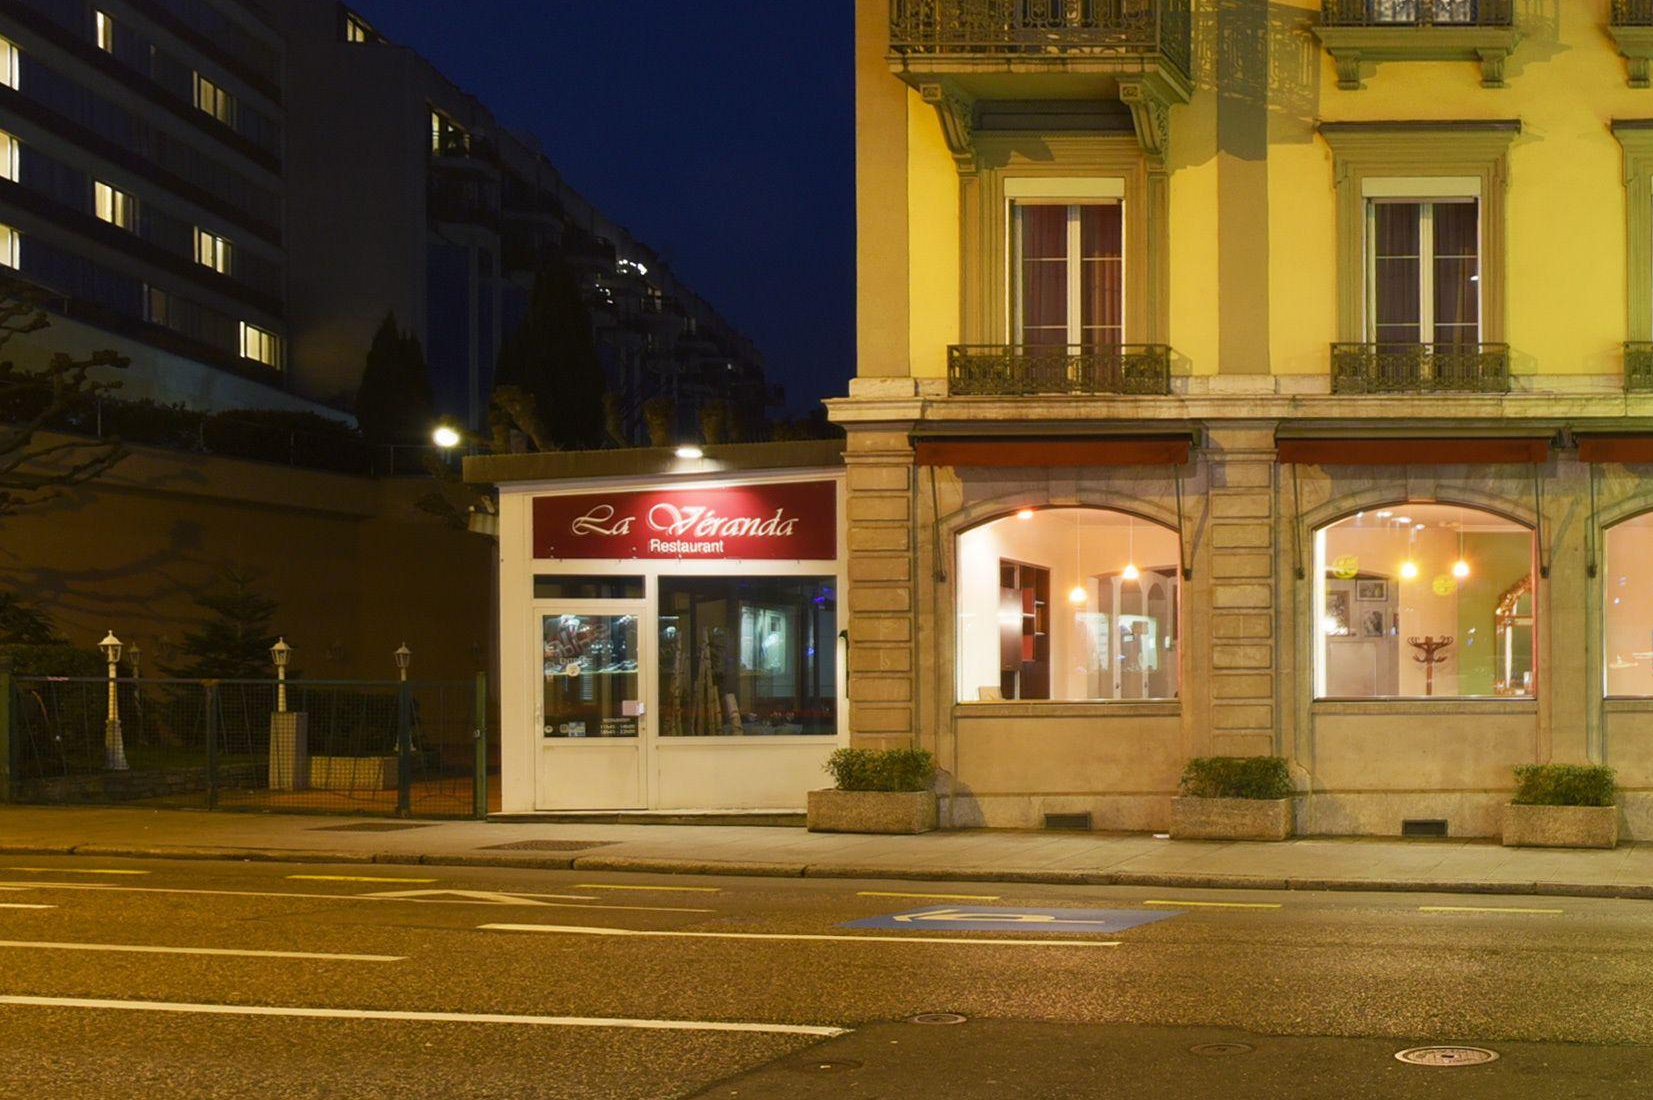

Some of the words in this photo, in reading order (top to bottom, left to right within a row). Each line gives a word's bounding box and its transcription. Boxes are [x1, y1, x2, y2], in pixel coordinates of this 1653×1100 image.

[572, 504, 635, 535] La
[648, 503, 799, 536] Véranda
[649, 538, 724, 553] Restaurant
